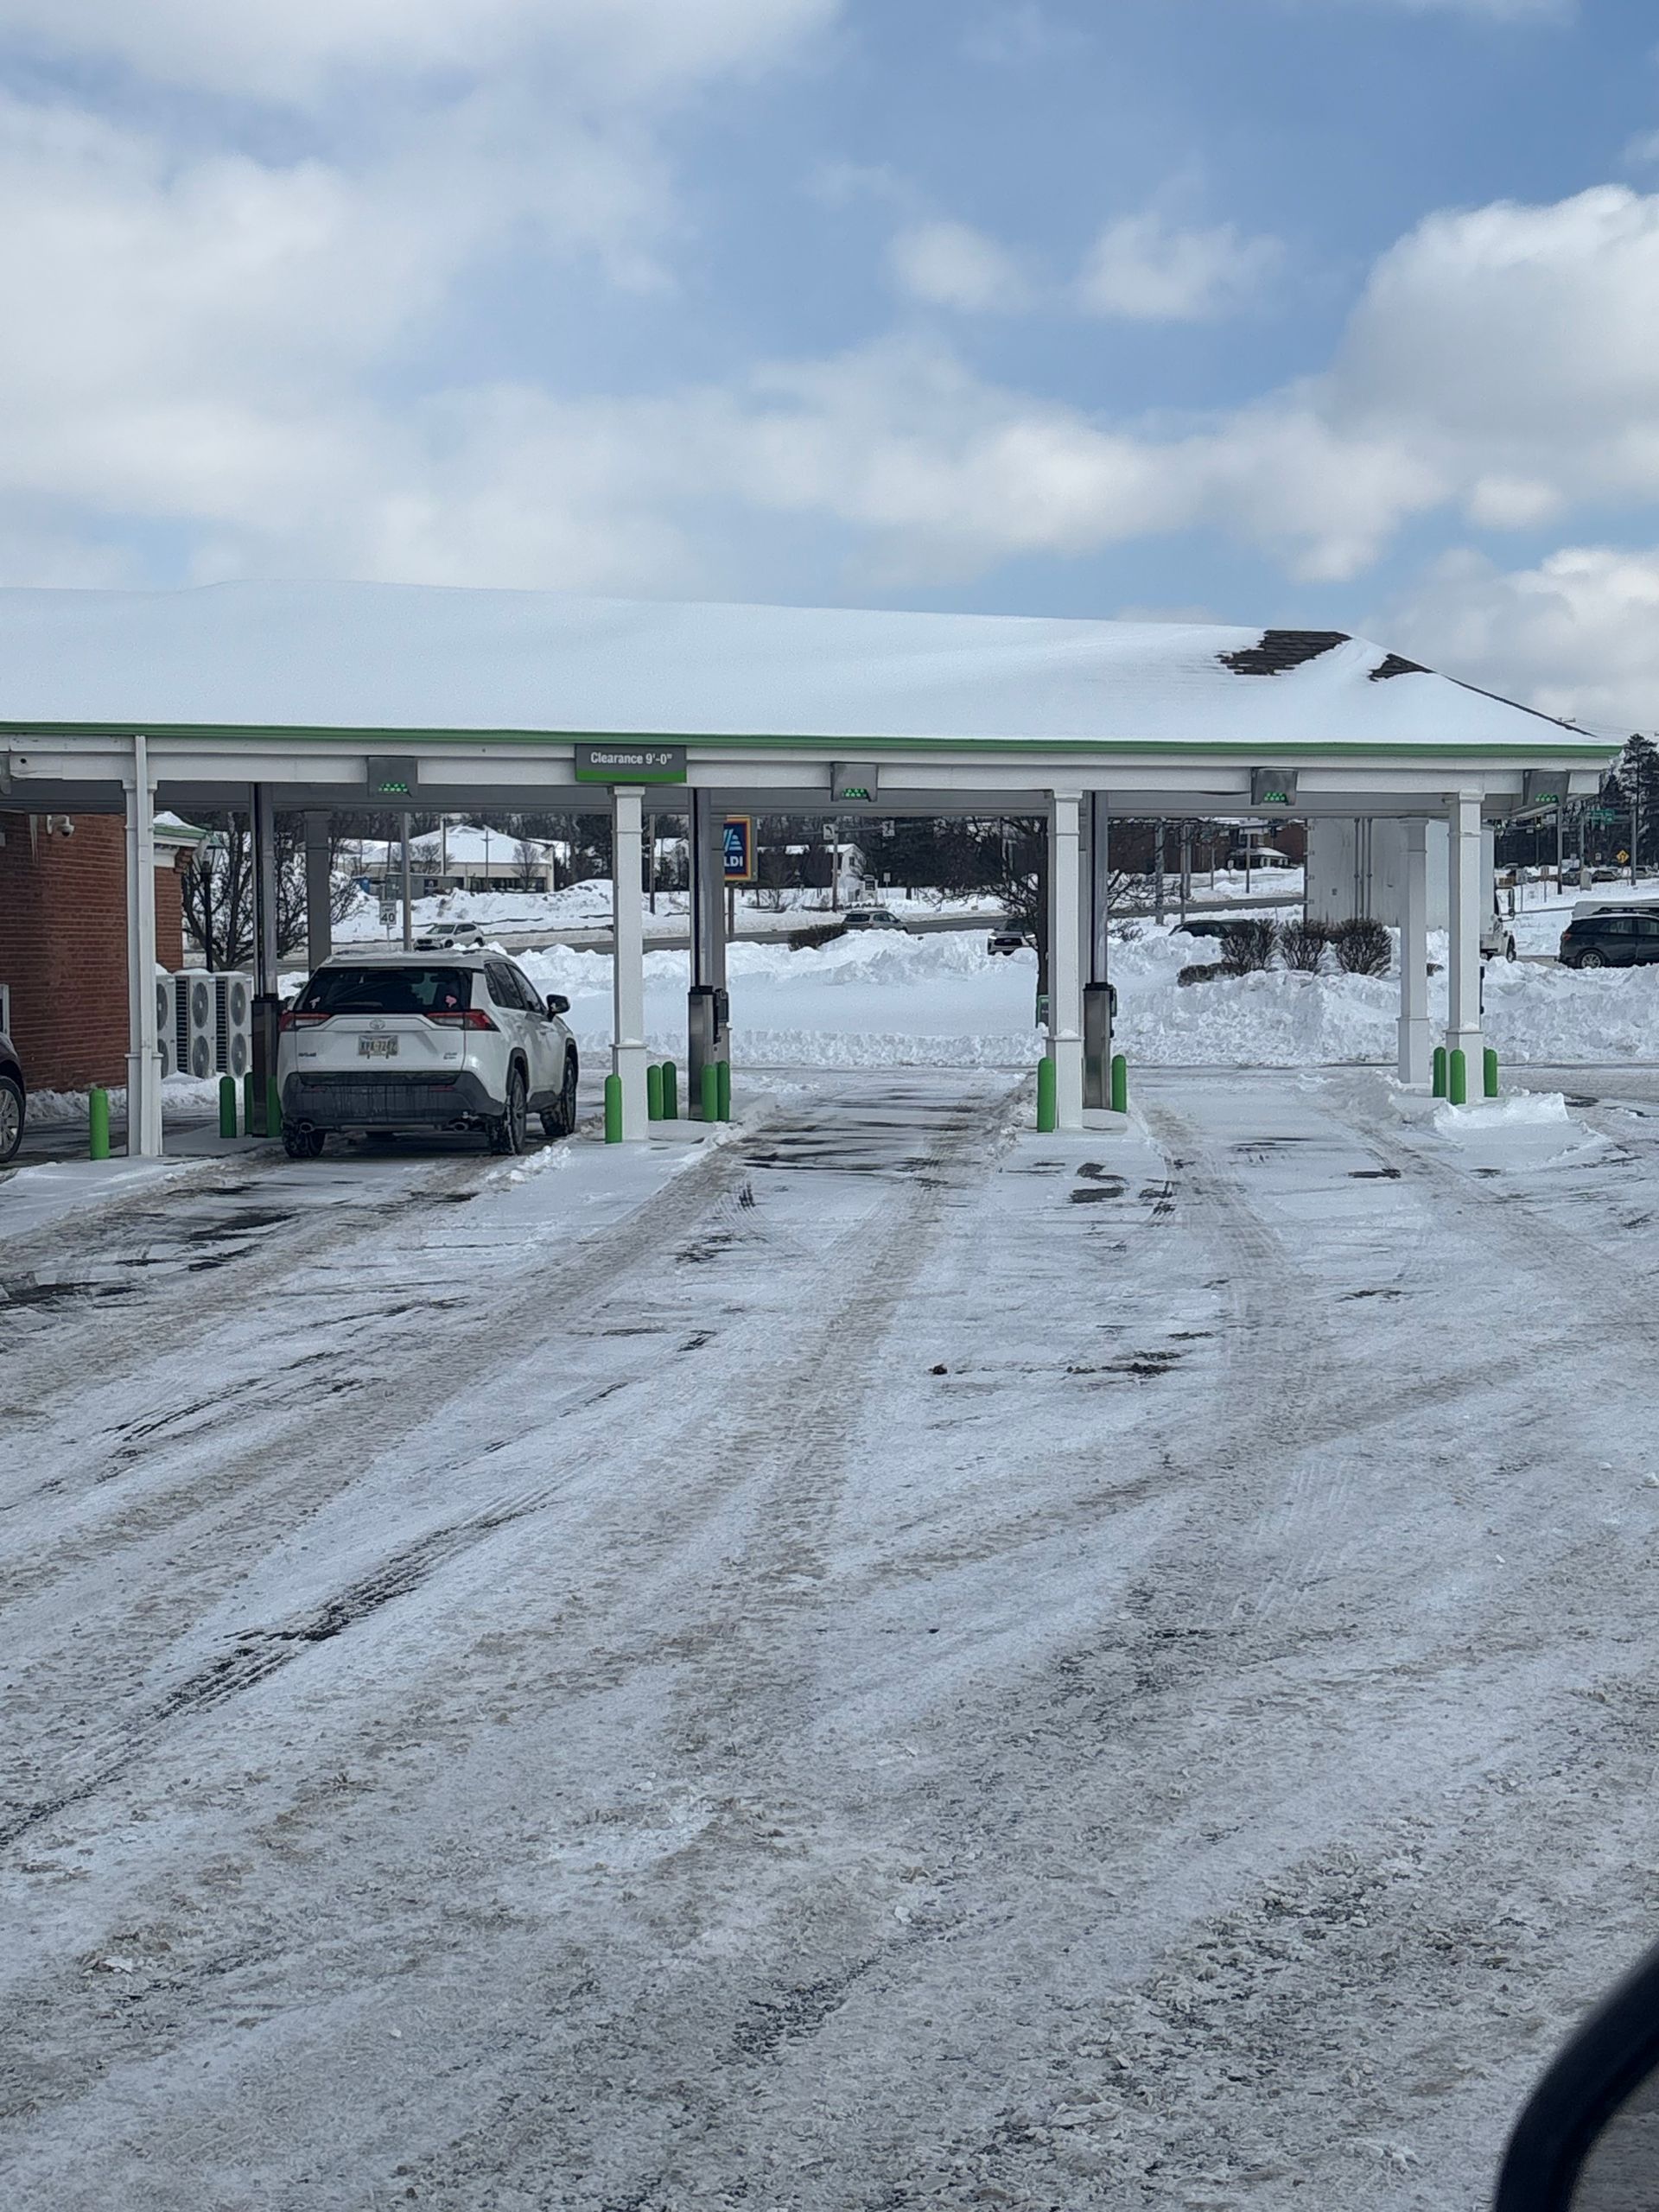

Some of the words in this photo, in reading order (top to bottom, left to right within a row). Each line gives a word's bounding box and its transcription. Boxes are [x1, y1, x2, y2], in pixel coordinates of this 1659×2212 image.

[590, 752, 643, 765] Clearance
[723, 855, 744, 868] LDI
[380, 912, 395, 922] 40
